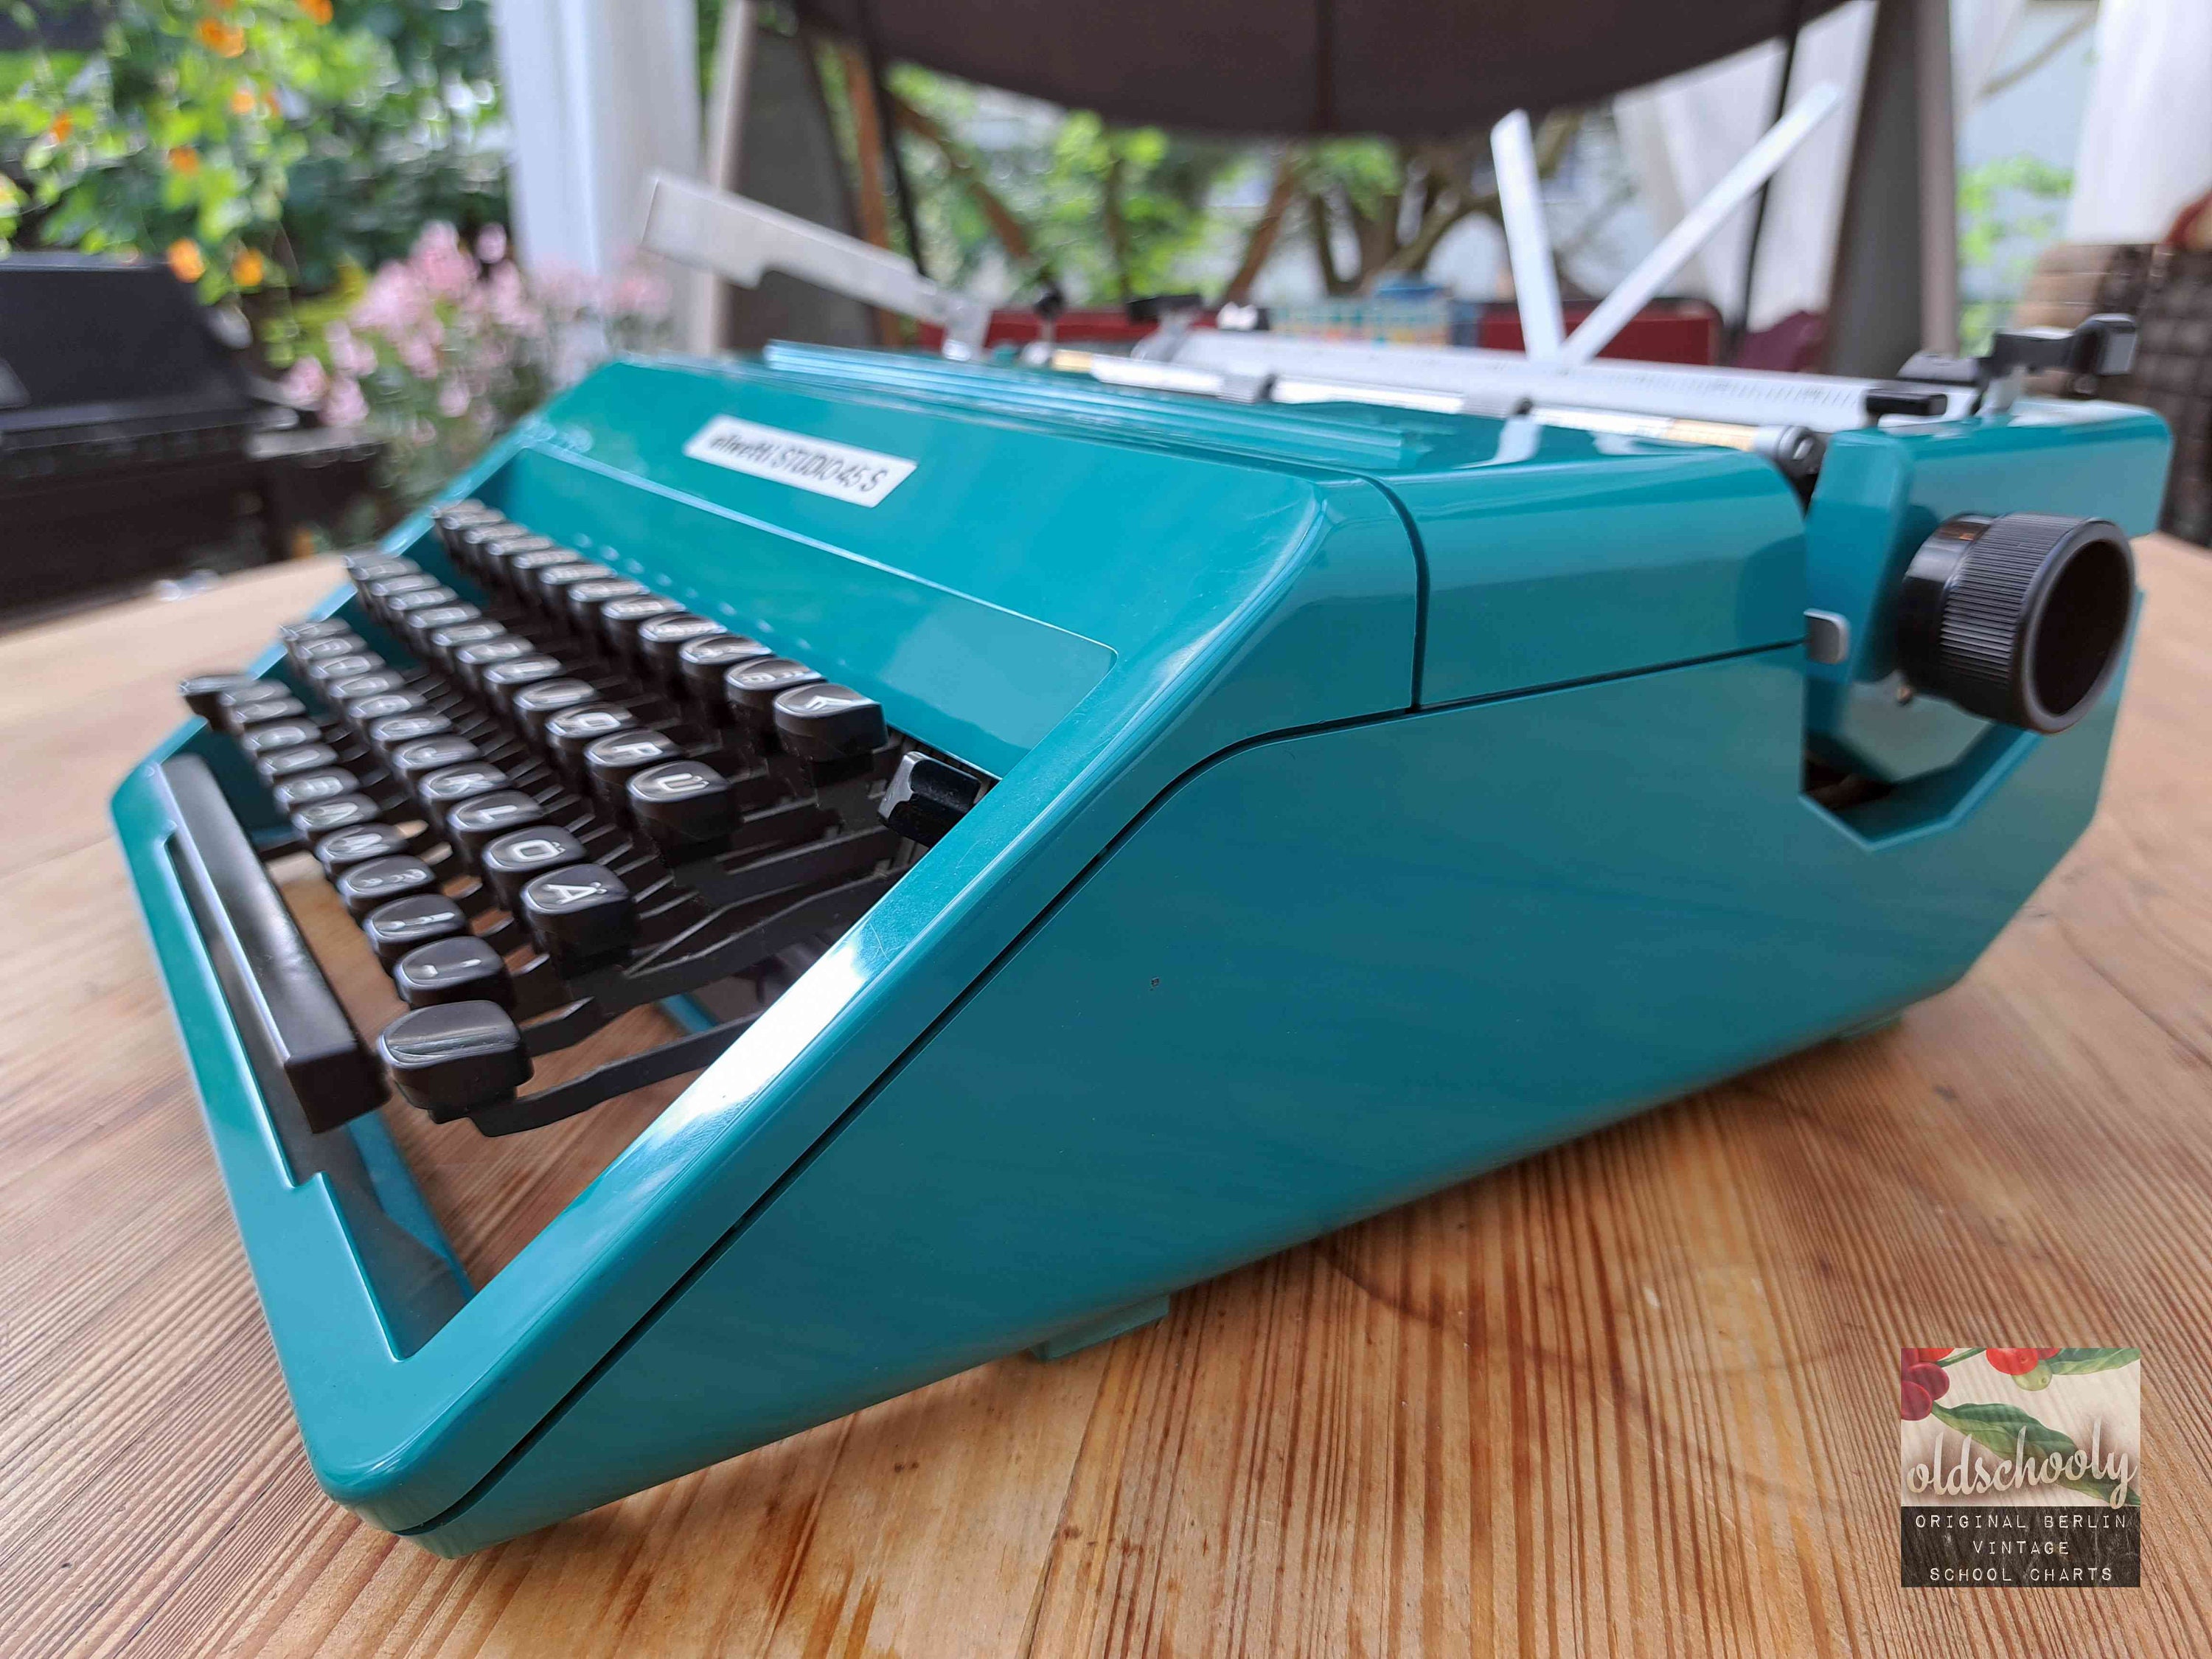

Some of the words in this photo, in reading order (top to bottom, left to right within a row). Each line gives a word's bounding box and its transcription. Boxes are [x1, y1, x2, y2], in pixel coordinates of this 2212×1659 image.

[611, 741, 663, 757] P
[656, 773, 710, 794] Ü
[513, 839, 567, 860] Ö
[546, 882, 608, 905] Ä
